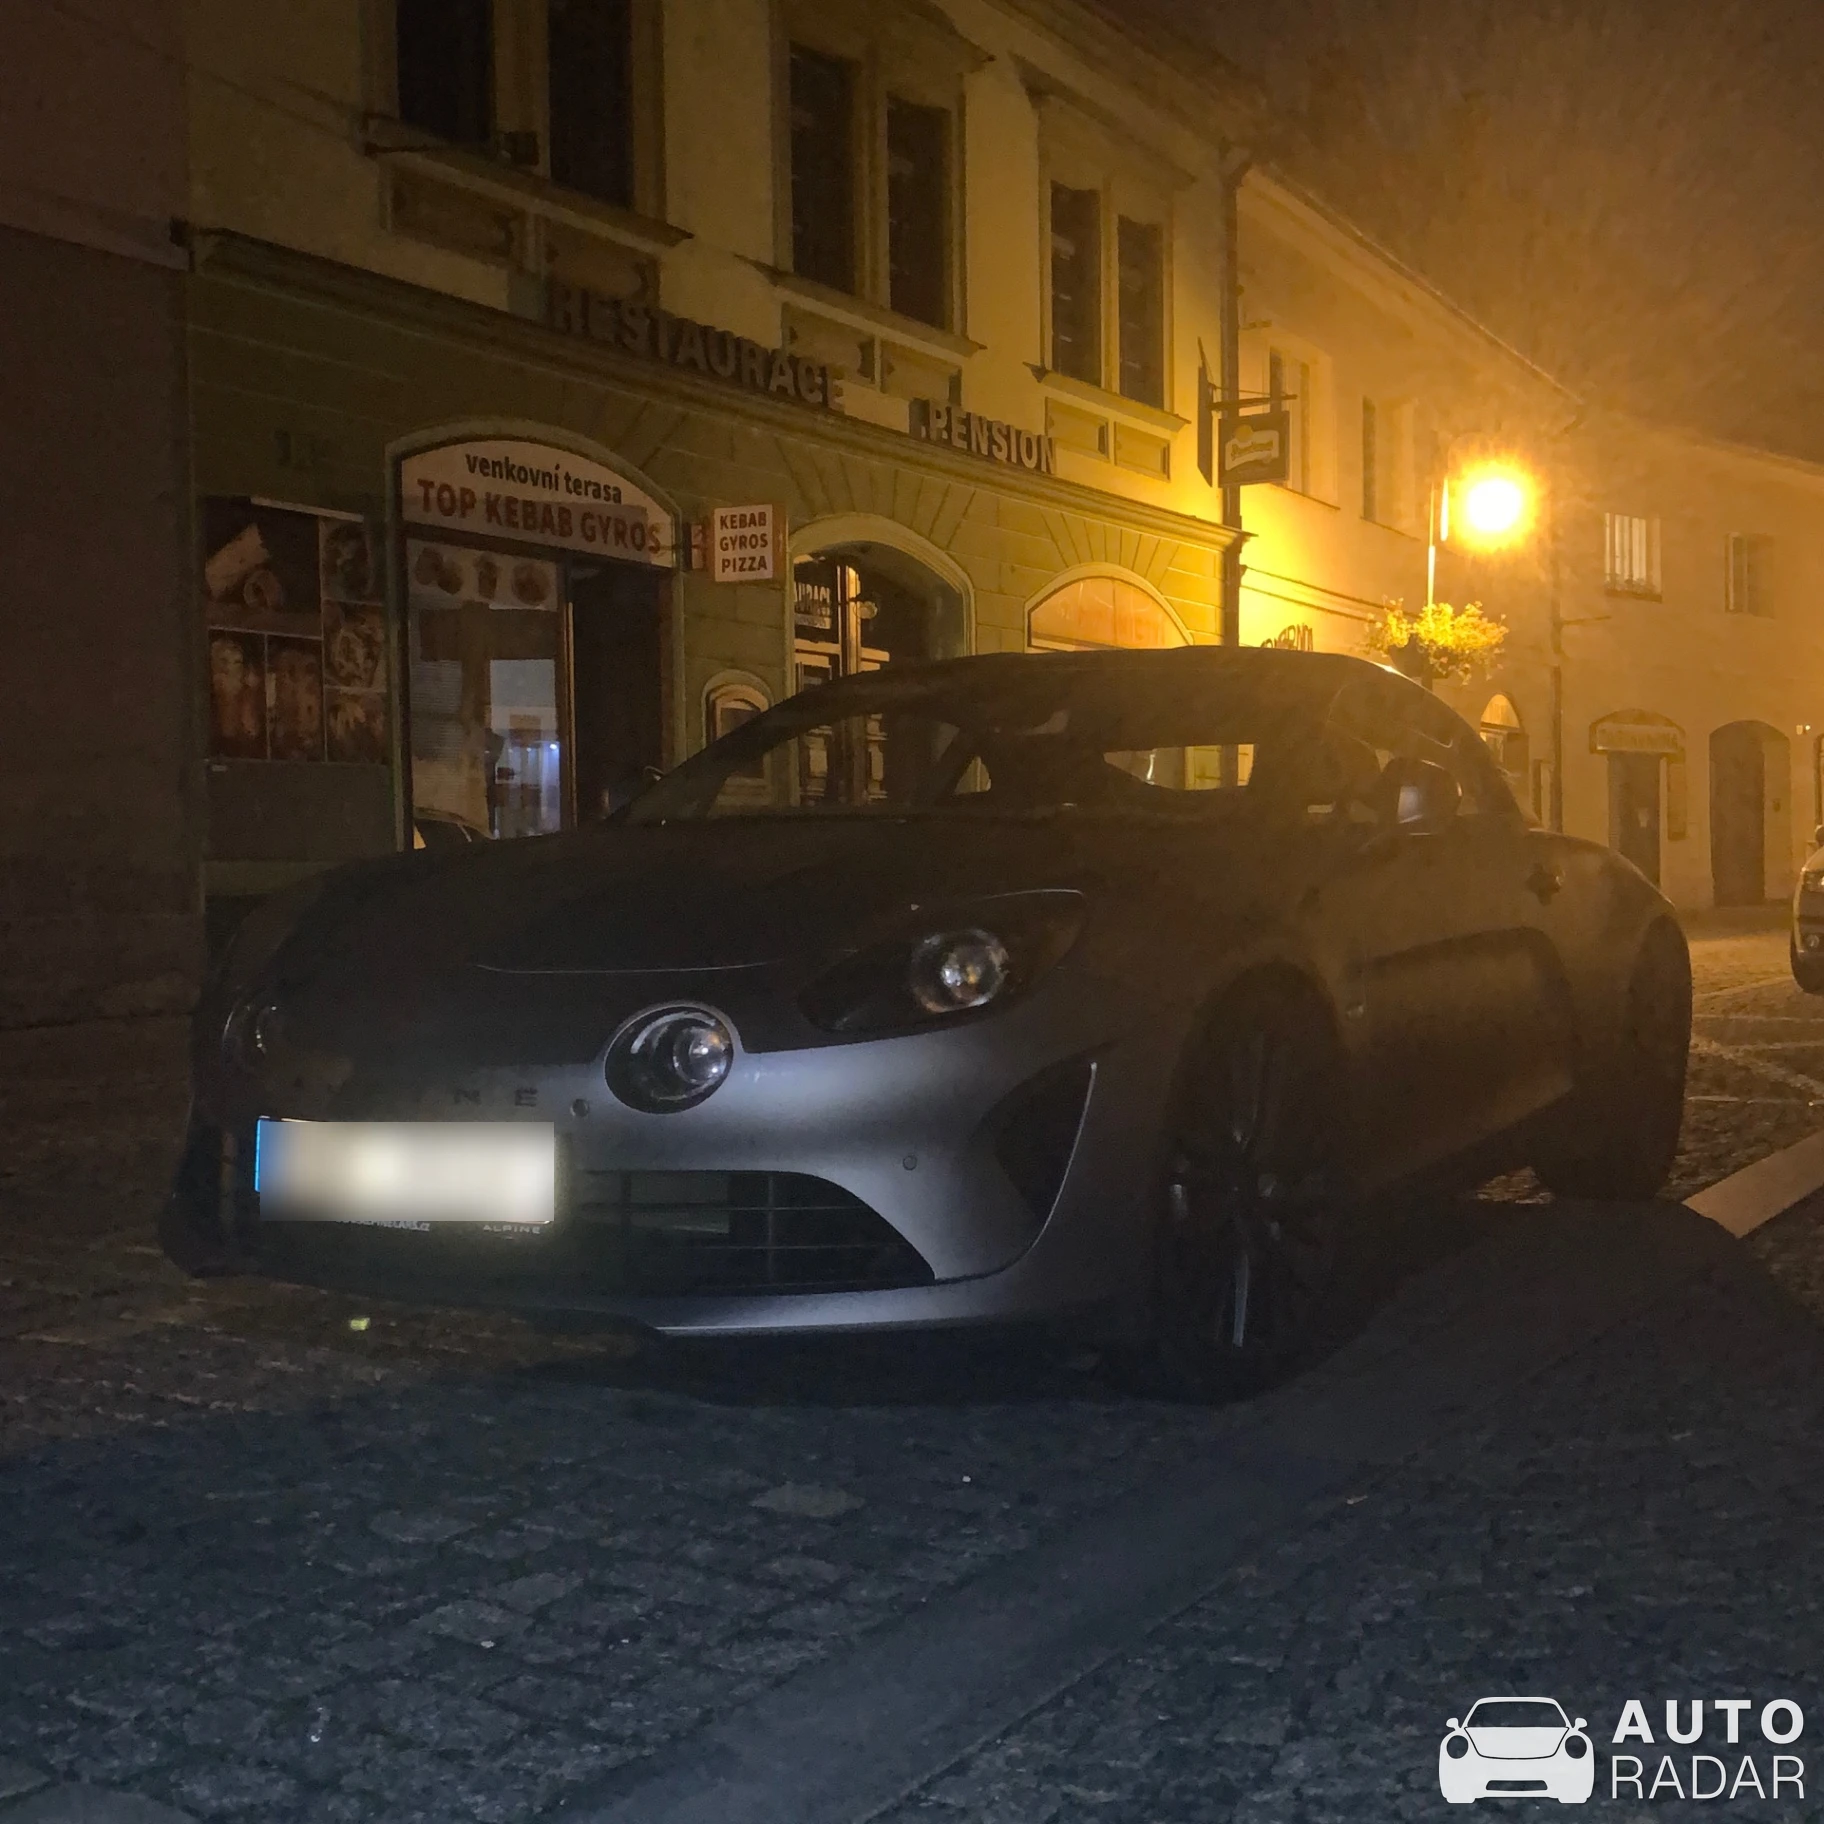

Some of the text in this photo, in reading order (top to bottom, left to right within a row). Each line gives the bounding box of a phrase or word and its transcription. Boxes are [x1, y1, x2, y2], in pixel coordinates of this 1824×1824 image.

[549, 281, 844, 412] RESTAURACE
[929, 400, 1057, 475] PENSION
[465, 454, 622, 504] venkovní terasa
[417, 478, 661, 554] TOP KEBAB GYROS
[720, 512, 767, 530] KEBAB
[720, 533, 768, 551] GYROS
[721, 556, 767, 573] PIZZA
[483, 1224, 541, 1235] ALPINE
